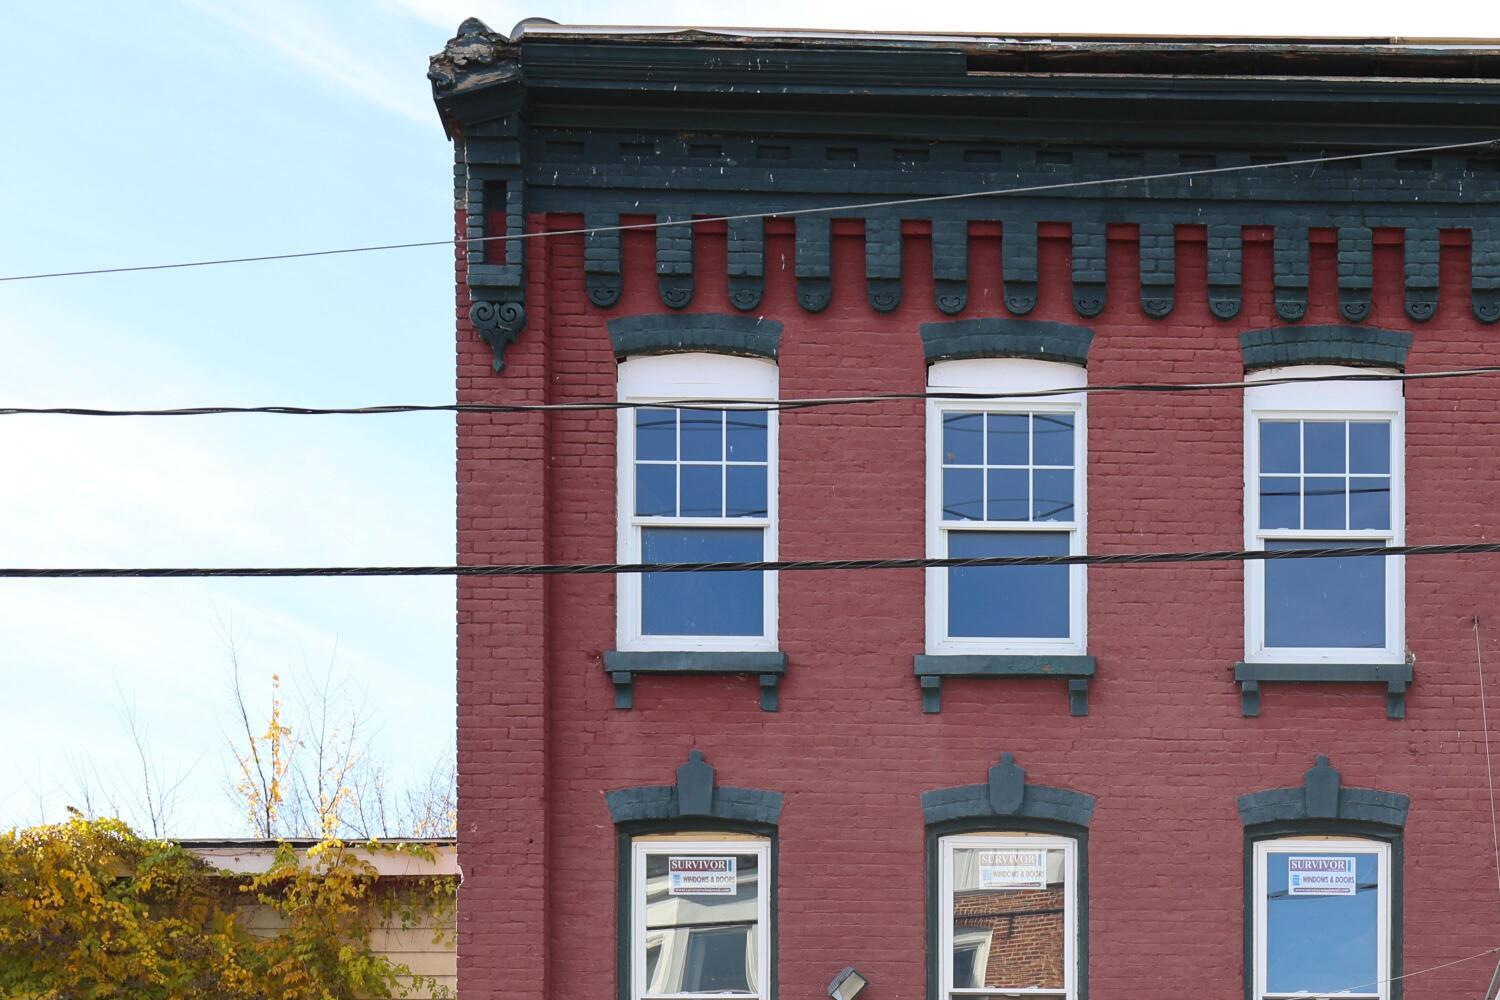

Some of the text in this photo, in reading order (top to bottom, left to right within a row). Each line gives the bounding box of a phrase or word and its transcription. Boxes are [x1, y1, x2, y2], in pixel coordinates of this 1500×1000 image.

[982, 855, 1034, 864] SURVIVOR
[671, 860, 725, 869] SURVIVOR
[1291, 860, 1345, 869] SURVIVOR
